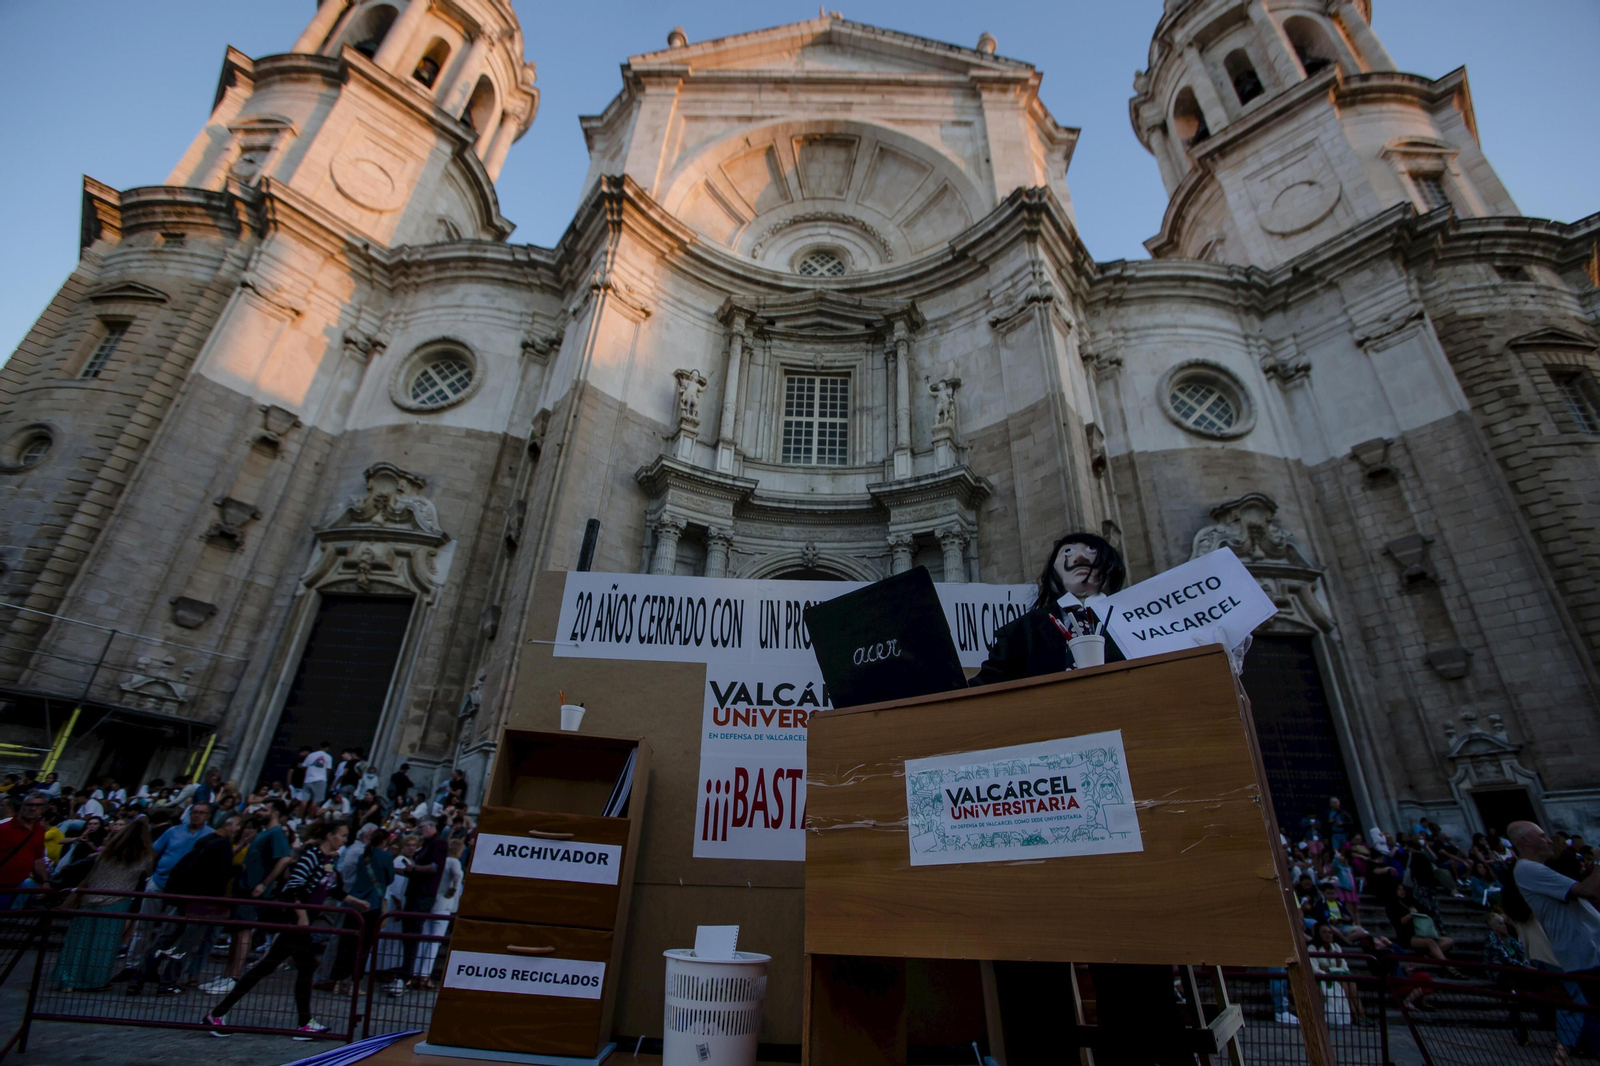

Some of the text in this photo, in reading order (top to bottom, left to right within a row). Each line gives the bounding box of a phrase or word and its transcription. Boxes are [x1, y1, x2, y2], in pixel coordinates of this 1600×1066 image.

[1122, 576, 1222, 622] PROYECTO
[569, 591, 592, 642] 20
[591, 583, 637, 644] AÑOS
[638, 594, 707, 647] CERRADO
[710, 597, 744, 648] CON
[759, 599, 781, 649] UN
[785, 600, 827, 650] PRO
[955, 602, 979, 652] UN
[1131, 595, 1241, 641] VALCARCEL
[853, 638, 902, 665] acer
[712, 707, 821, 728] UNiVER
[754, 733, 764, 741] DE
[766, 733, 806, 742] VALCÁRCEL
[702, 767, 806, 842] ¡¡¡BAST
[945, 775, 1077, 809] VALCÁRCEL
[1044, 814, 1082, 822] UNIVERSITARIA
[492, 843, 609, 866] ARCHIVADOR
[456, 964, 600, 987] FOLIOS RECICLADOS
